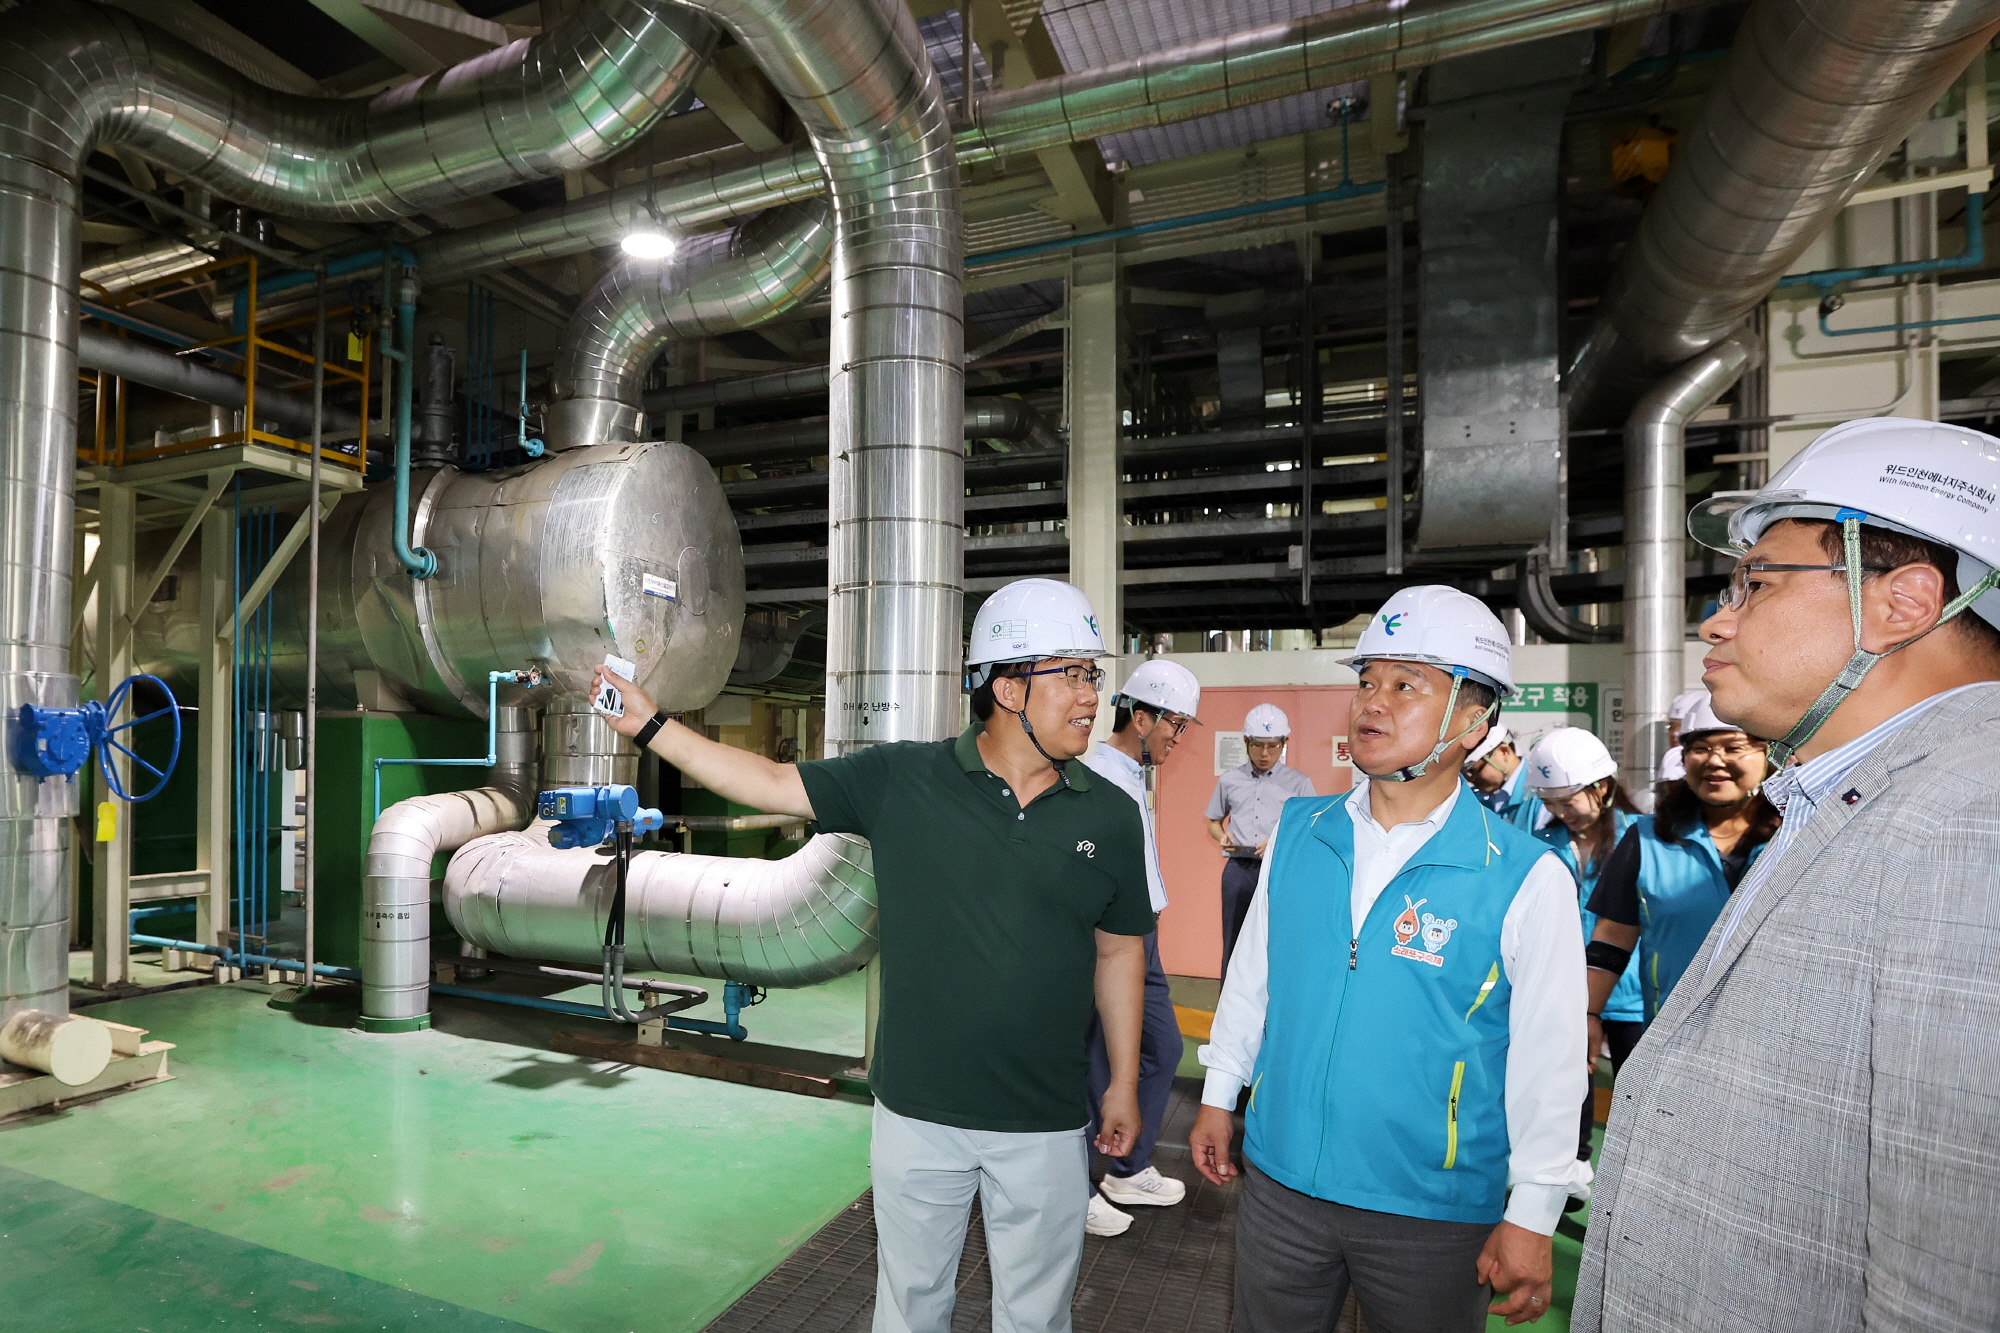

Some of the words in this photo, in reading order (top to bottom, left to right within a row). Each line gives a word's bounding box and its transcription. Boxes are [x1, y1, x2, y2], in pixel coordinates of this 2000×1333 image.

[1879, 476, 1897, 485] With
[1899, 479, 1929, 491] Incheon
[1930, 486, 1956, 500] Energy
[1956, 494, 1989, 514] Company
[1885, 464, 1996, 505] 위드인천에너지주식회사
[843, 702, 855, 711] DH
[857, 702, 869, 711] #2
[872, 702, 900, 712] 난방수
[1502, 686, 1545, 707] 호구
[1552, 686, 1589, 707] 착용
[1392, 945, 1444, 966] 소래포구축제
